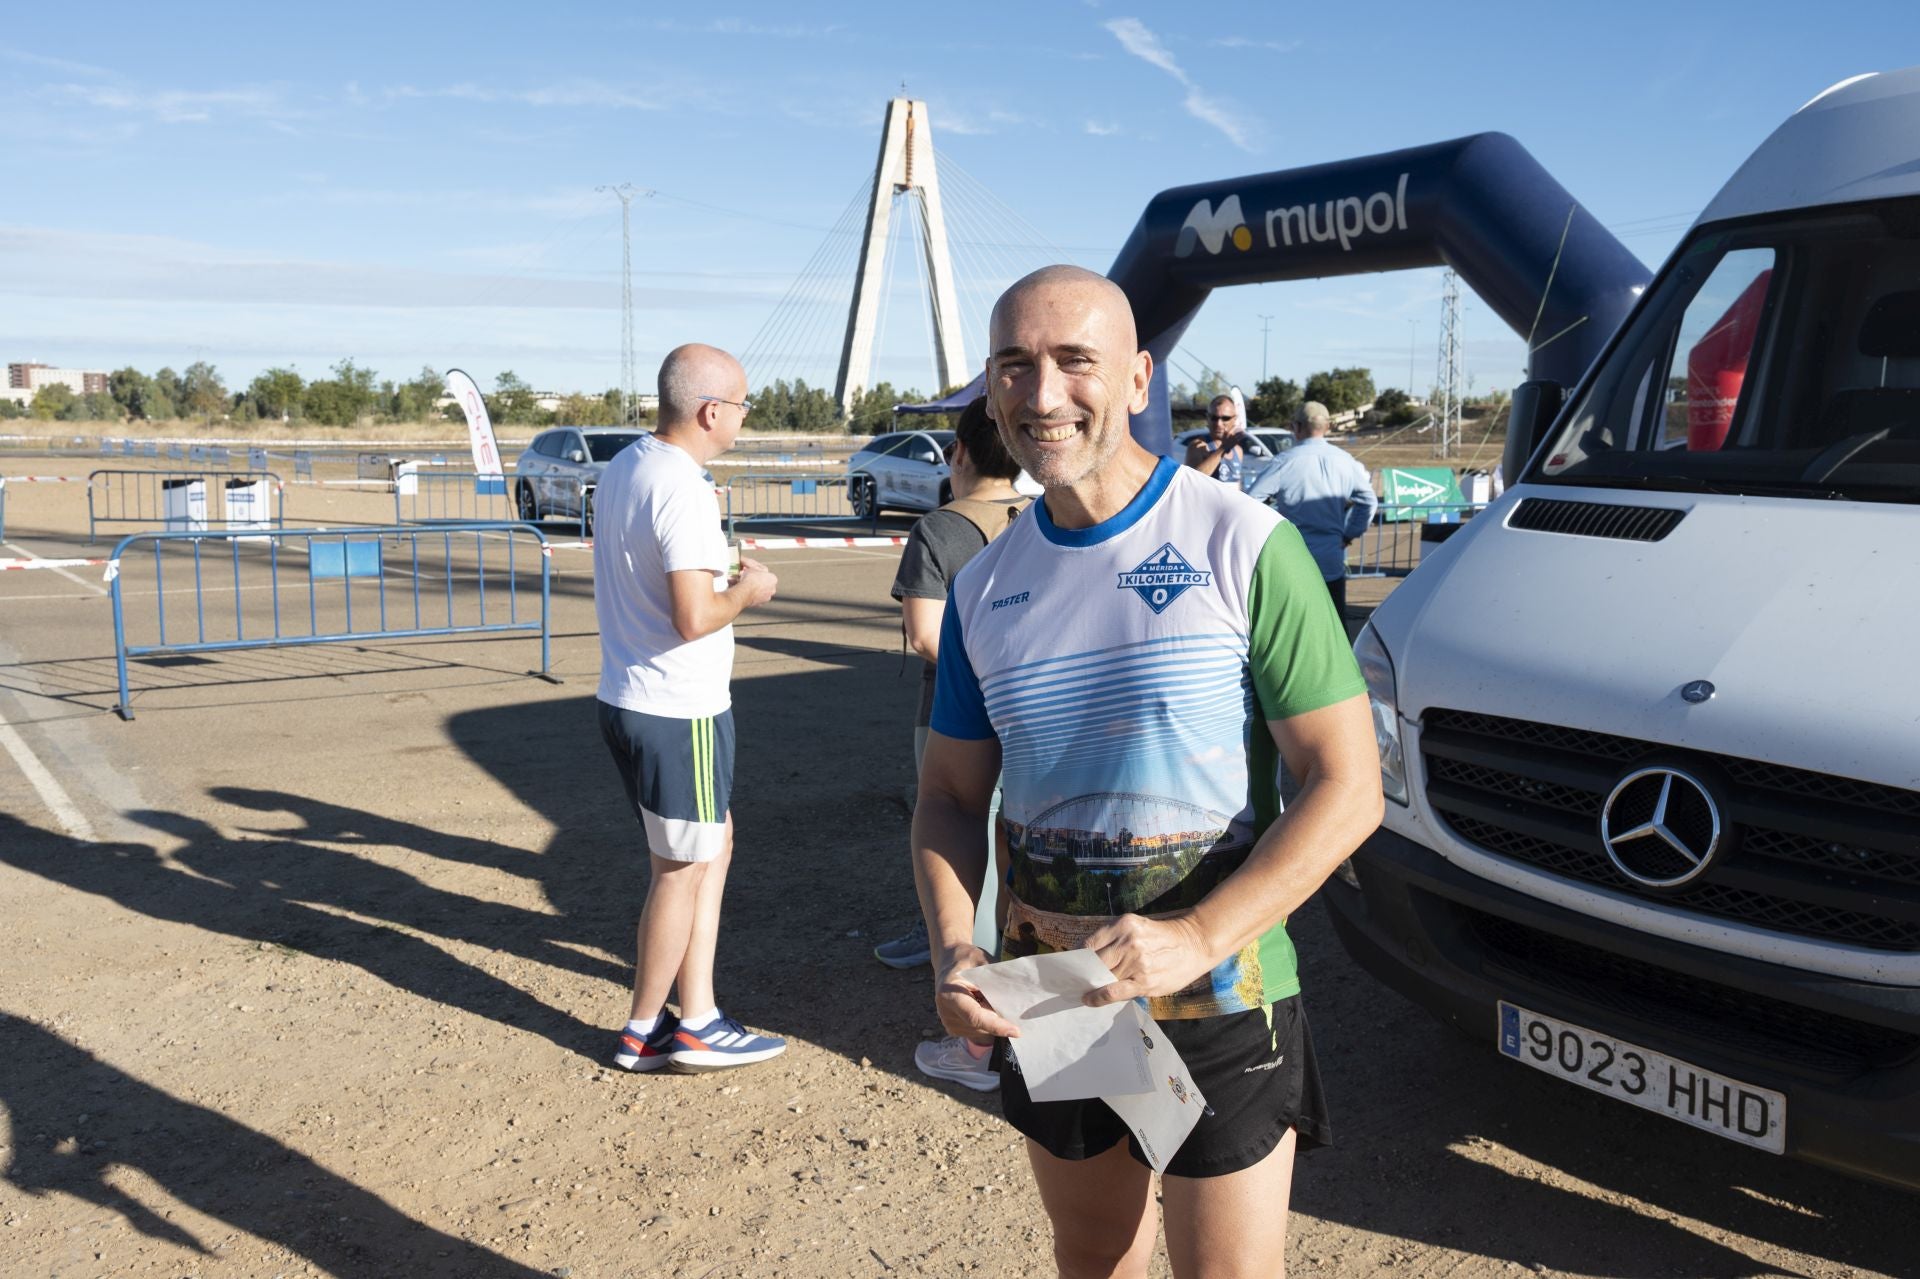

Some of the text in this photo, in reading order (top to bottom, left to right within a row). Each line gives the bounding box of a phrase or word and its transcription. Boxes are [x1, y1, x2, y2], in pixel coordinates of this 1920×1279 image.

[1265, 172, 1410, 250] mupol
[991, 591, 1030, 611] FASTER
[1506, 1033, 1516, 1048] E
[1527, 1020, 1769, 1138] 9023 HHD
